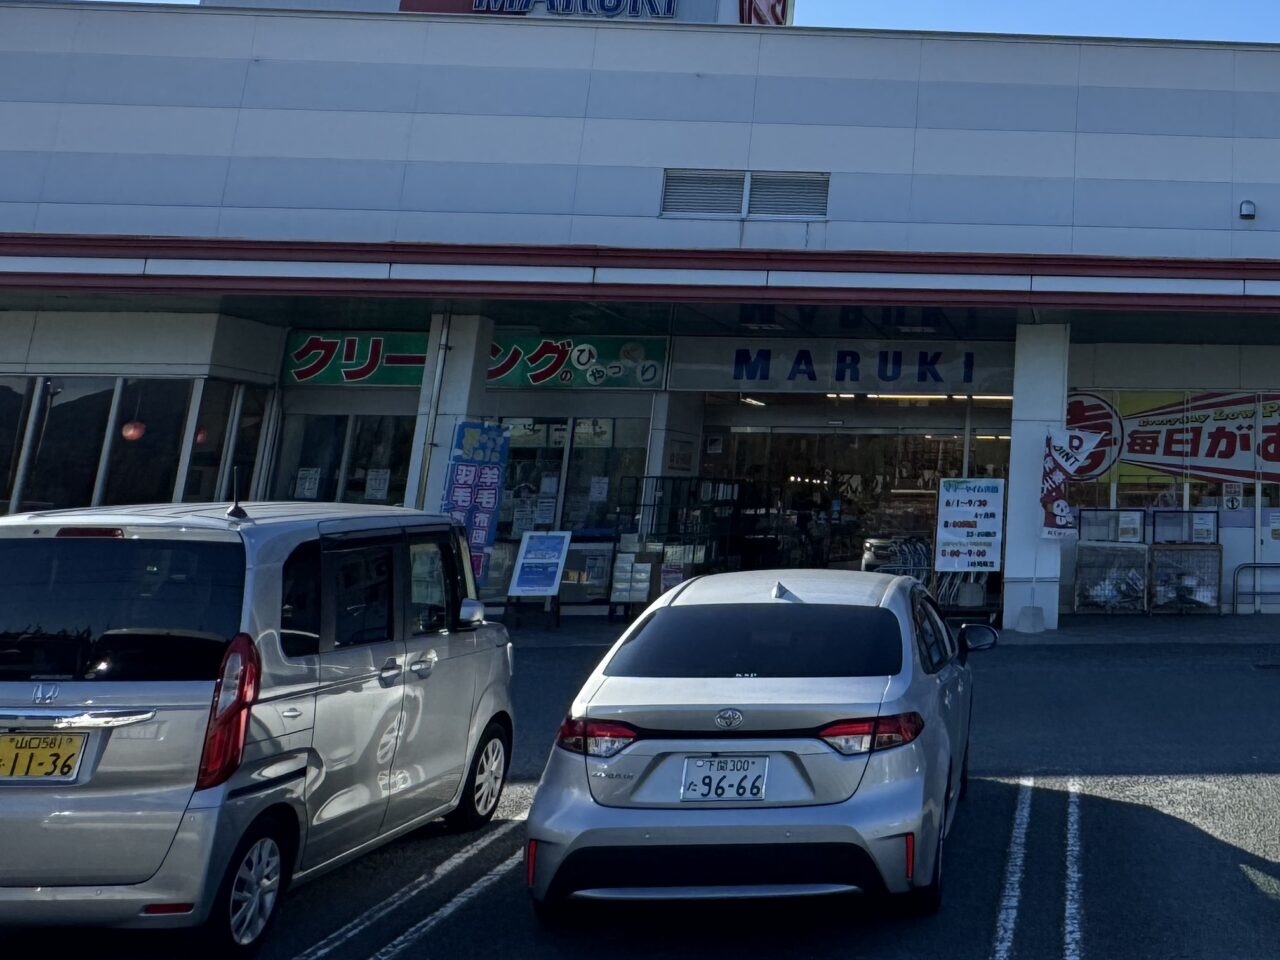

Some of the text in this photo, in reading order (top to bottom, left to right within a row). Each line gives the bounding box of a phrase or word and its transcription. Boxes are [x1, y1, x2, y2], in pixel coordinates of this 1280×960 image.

[733, 348, 975, 383] MARUKI
[1213, 407, 1256, 422] Low
[15, 737, 63, 749] 山口581
[9, 752, 76, 776] 11-36
[700, 774, 762, 797] 96-66
